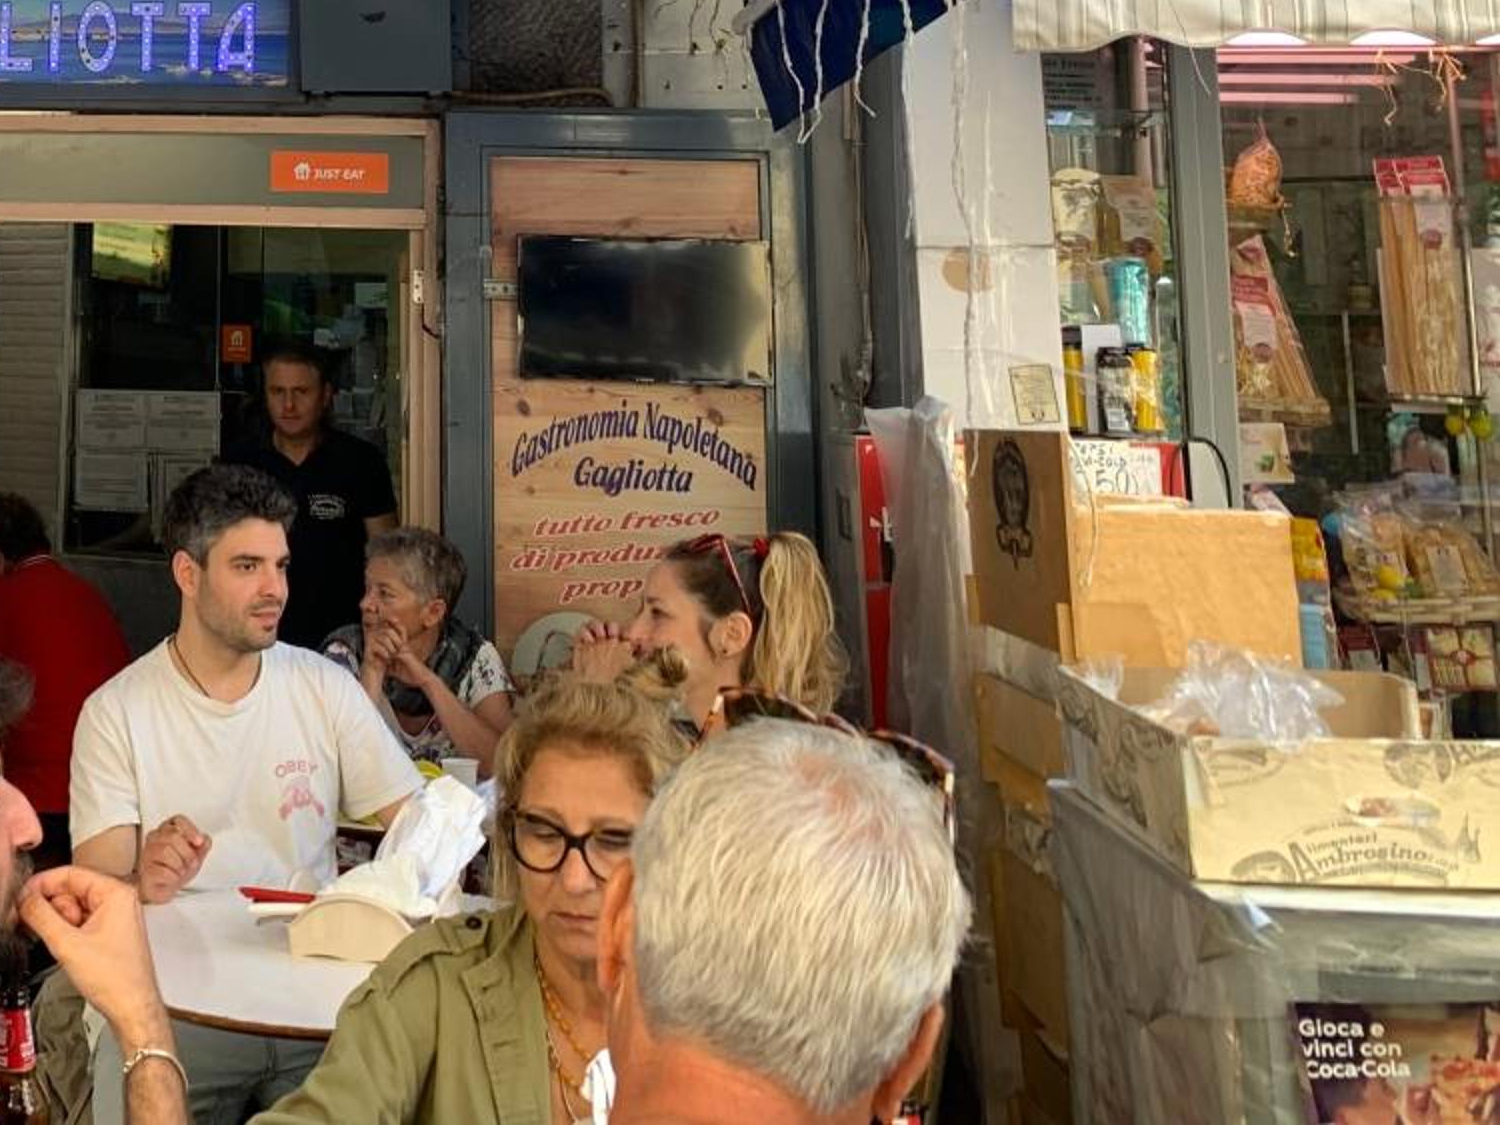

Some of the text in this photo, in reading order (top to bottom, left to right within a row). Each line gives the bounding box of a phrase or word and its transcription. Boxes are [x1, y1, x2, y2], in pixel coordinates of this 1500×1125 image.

[314, 168, 366, 180] JUST EAT
[511, 399, 758, 491] Gastronomia Napoletana
[573, 456, 694, 497] Gagliotta
[534, 508, 720, 537] tutto fresco
[510, 542, 663, 572] di produ
[560, 576, 644, 604] prop
[1298, 1018, 1386, 1038] Gioca e
[1302, 1038, 1403, 1058] vinci con
[1305, 1058, 1413, 1079] Coca-Cola
